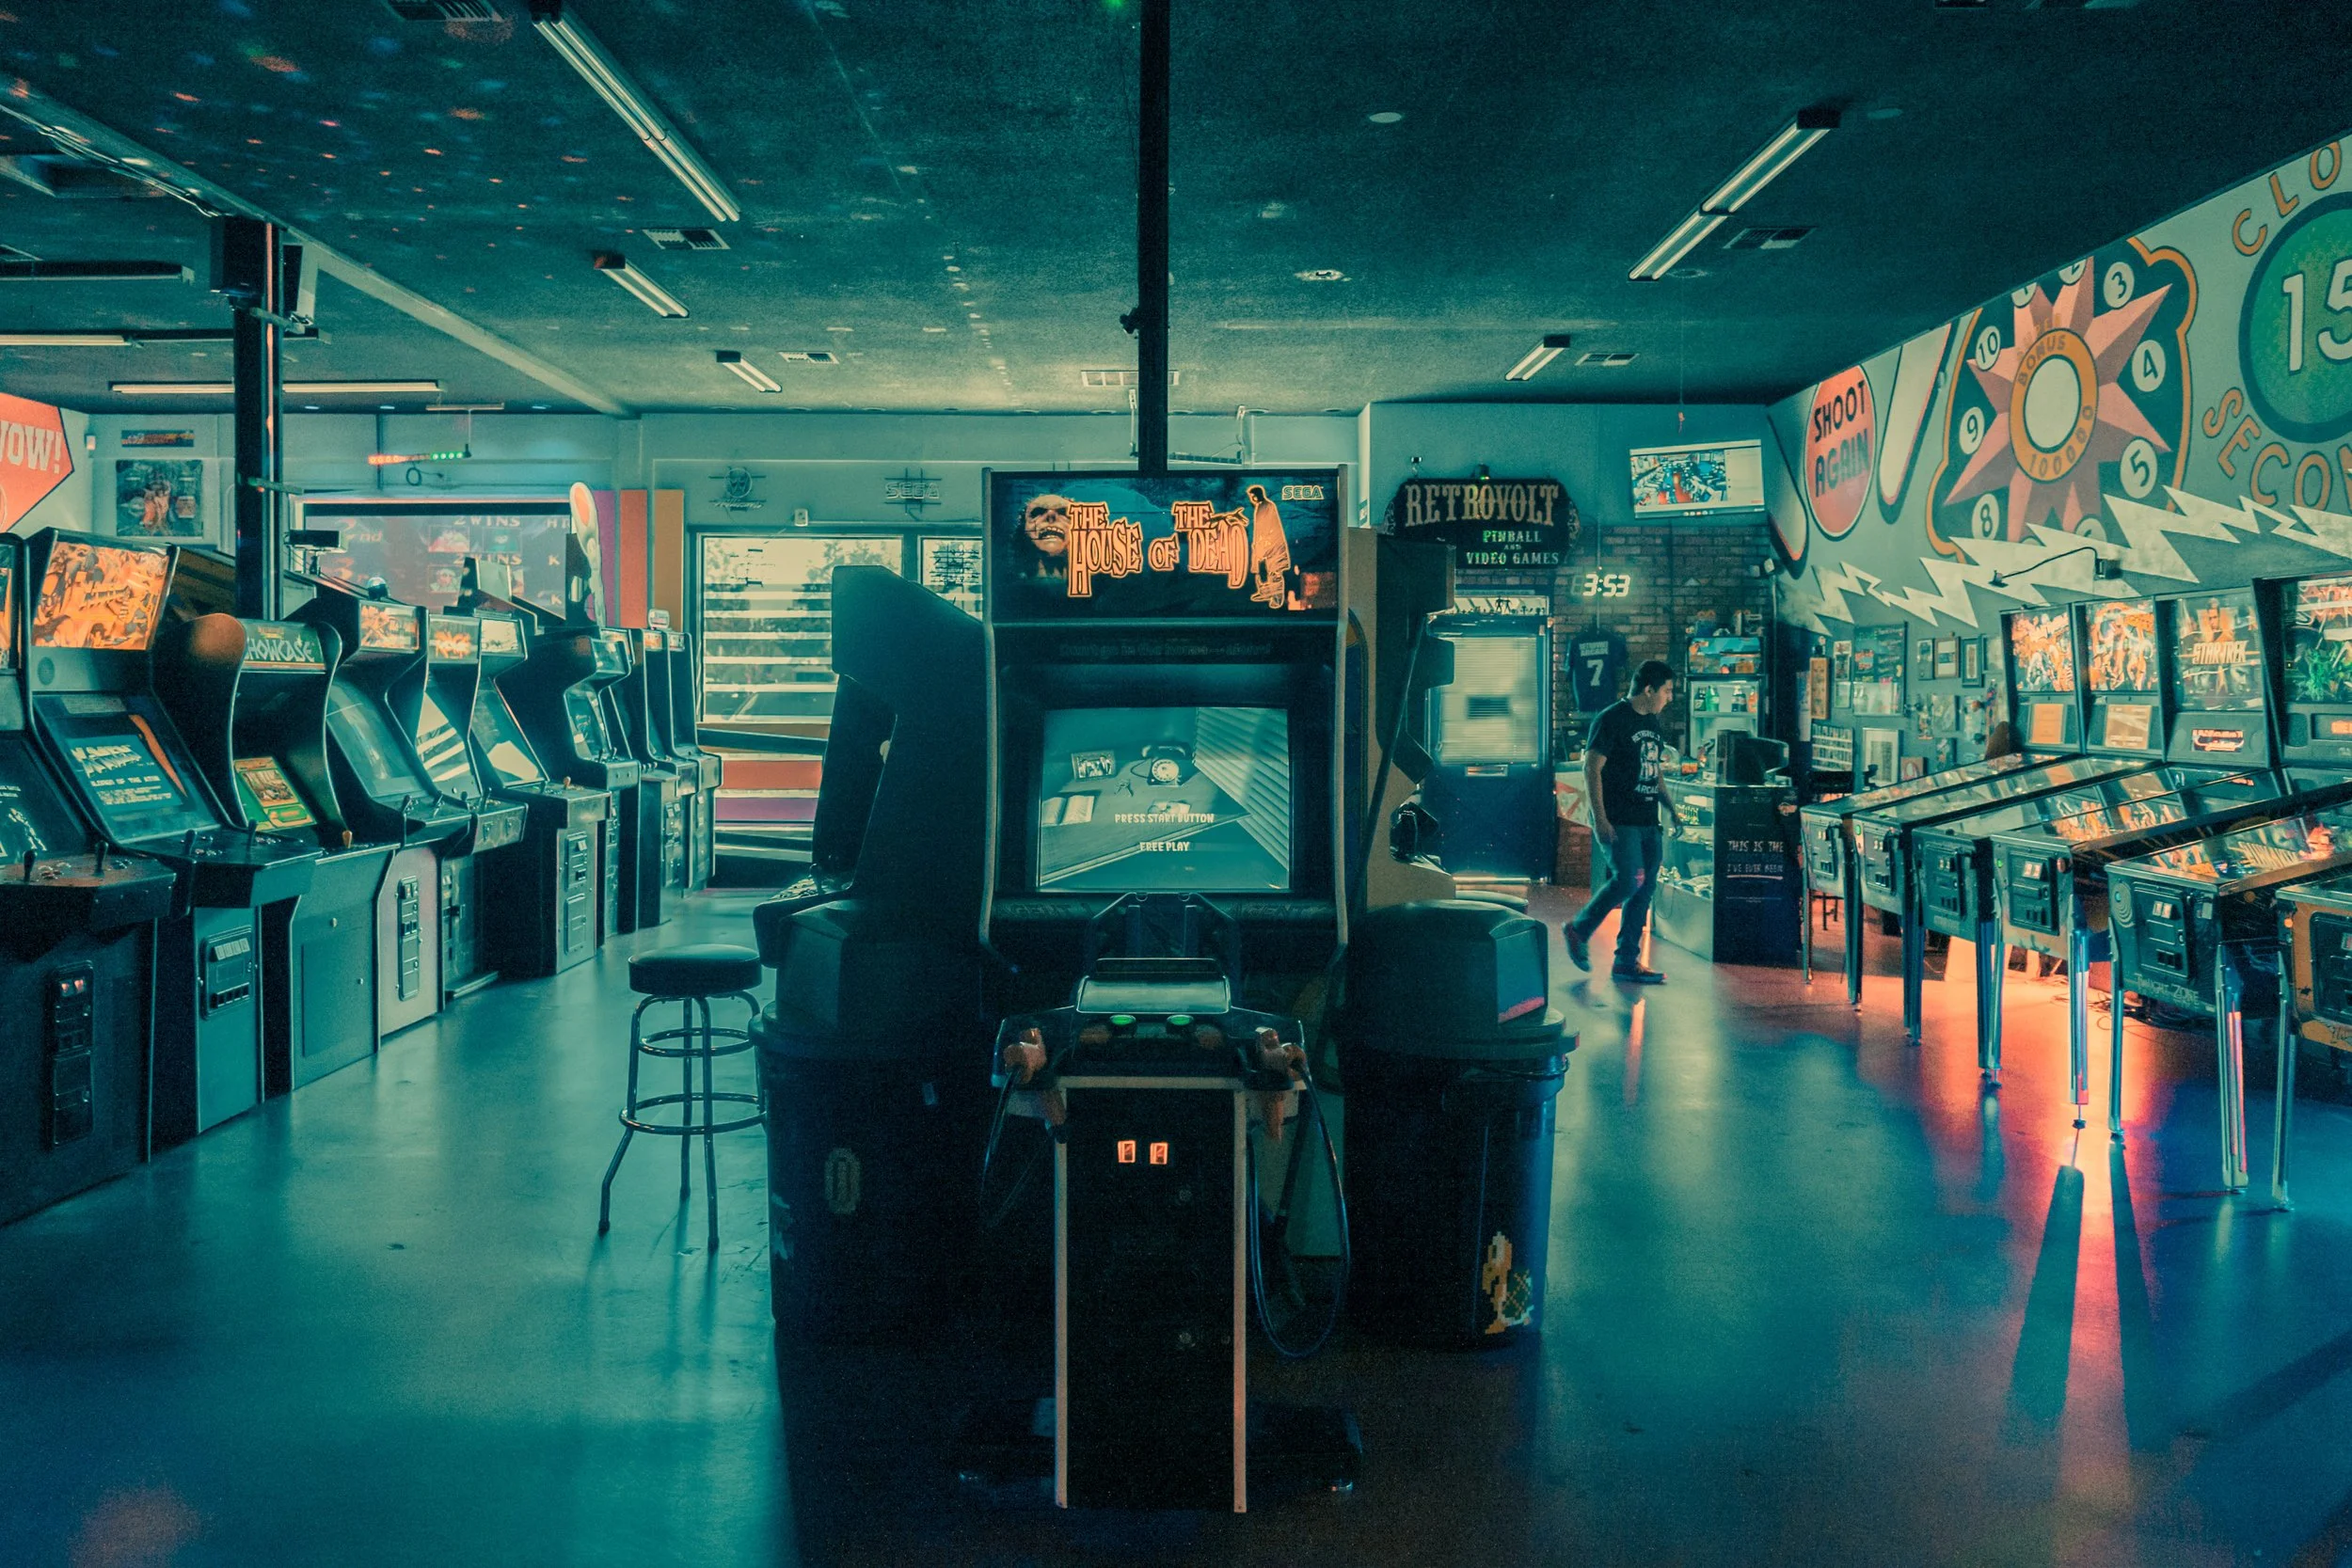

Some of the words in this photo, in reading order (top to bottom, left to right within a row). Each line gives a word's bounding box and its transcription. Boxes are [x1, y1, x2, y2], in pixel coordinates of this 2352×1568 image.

[2111, 271, 2127, 299] 3
[1979, 331, 1998, 364] 10
[2018, 334, 2067, 387] BONUS
[2141, 348, 2158, 380] 4
[1814, 380, 1865, 443] SHOOT
[1966, 414, 1979, 443] 9
[1815, 428, 1869, 498] AGAIN
[2129, 449, 2151, 487] 5
[885, 482, 940, 499] SEGA
[1281, 485, 1324, 500] SEGA
[1405, 483, 1559, 527] RETROVOLT
[1068, 501, 1110, 530] THE
[1173, 501, 1214, 530] THE
[1980, 503, 1993, 537] 8
[1483, 531, 1542, 543] PINBALL
[1067, 517, 1142, 597] HOUSE
[1149, 533, 1179, 571] OF
[1187, 522, 1249, 589] DEAD
[1466, 552, 1506, 564] VIDEO
[1513, 552, 1559, 564] GAMES
[1582, 573, 1630, 596] 3:53
[2192, 641, 2220, 664] STAR
[2219, 641, 2249, 664] TREK
[1587, 659, 1603, 687] 7
[1115, 814, 1146, 823] PRESS
[1147, 814, 1176, 823] START
[1177, 814, 1215, 823] BUTTON
[1139, 842, 1164, 851] FREE
[1166, 842, 1190, 851] PLAY
[1727, 840, 1749, 852] THIS
[1753, 841, 1764, 852] IS
[1768, 841, 1784, 853] THE
